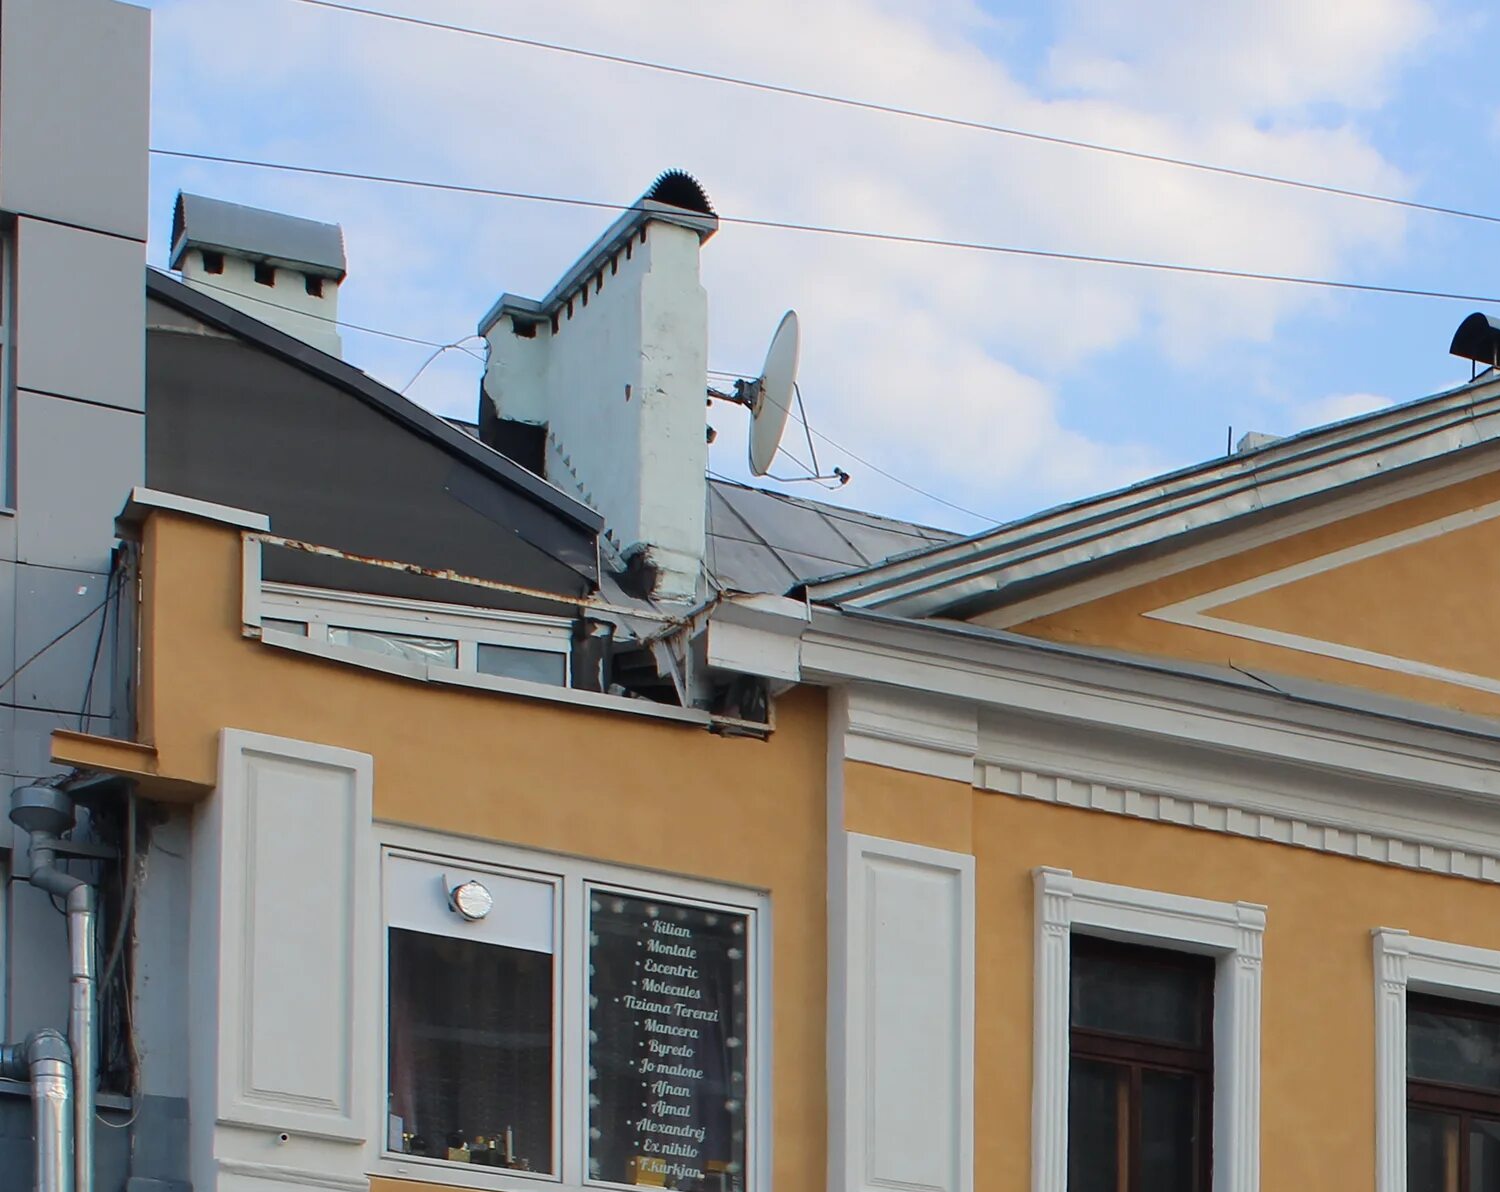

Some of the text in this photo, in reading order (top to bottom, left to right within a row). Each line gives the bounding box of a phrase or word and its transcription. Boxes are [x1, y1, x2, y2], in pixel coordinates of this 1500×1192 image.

[653, 920, 691, 938] Kilian
[647, 939, 697, 959] Montale
[644, 959, 699, 979] Escentric
[642, 978, 701, 999] Molecules
[623, 995, 719, 1022] Tiziana Terenzi
[644, 1018, 699, 1039] Mancera
[648, 1039, 696, 1057] Byredo
[639, 1058, 704, 1079] Jo malone
[651, 1080, 691, 1097] Afnan
[651, 1100, 691, 1117] Ajmal
[643, 1138, 699, 1158] Ex nihilo
